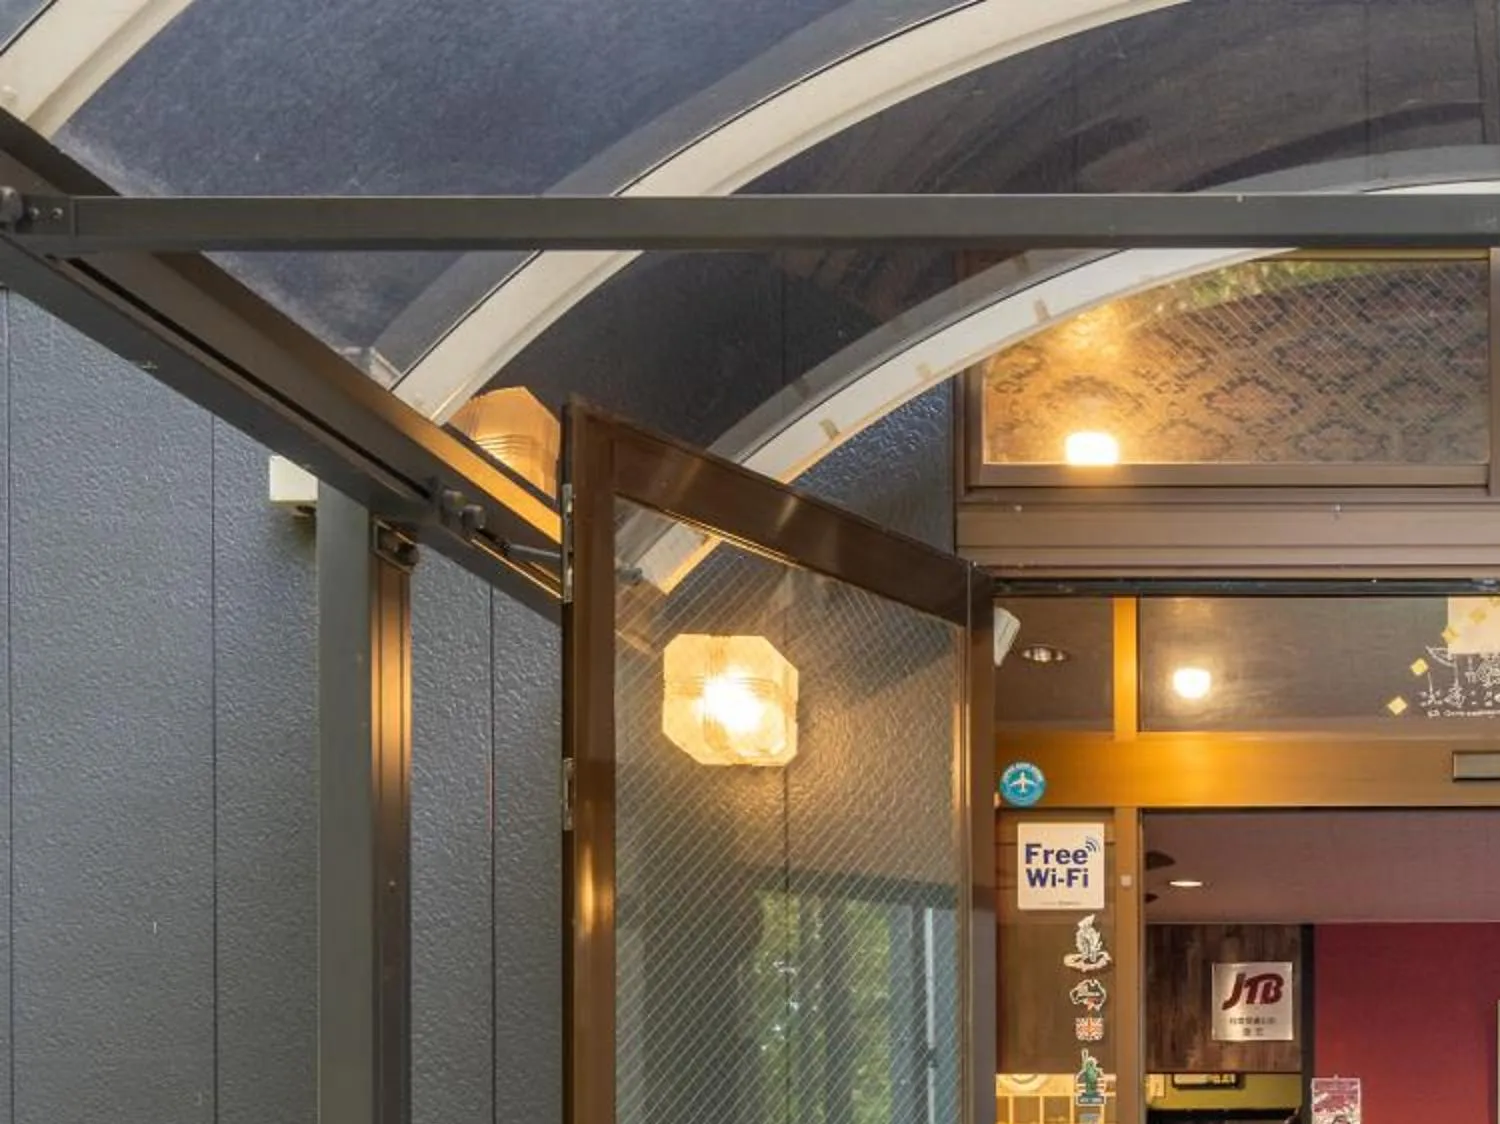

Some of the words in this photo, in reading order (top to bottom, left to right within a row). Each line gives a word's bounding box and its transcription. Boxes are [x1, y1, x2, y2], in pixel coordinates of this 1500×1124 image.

[1025, 843, 1088, 865] Free
[1026, 868, 1089, 888] Wi-Fi
[1222, 972, 1285, 1011] JTB
